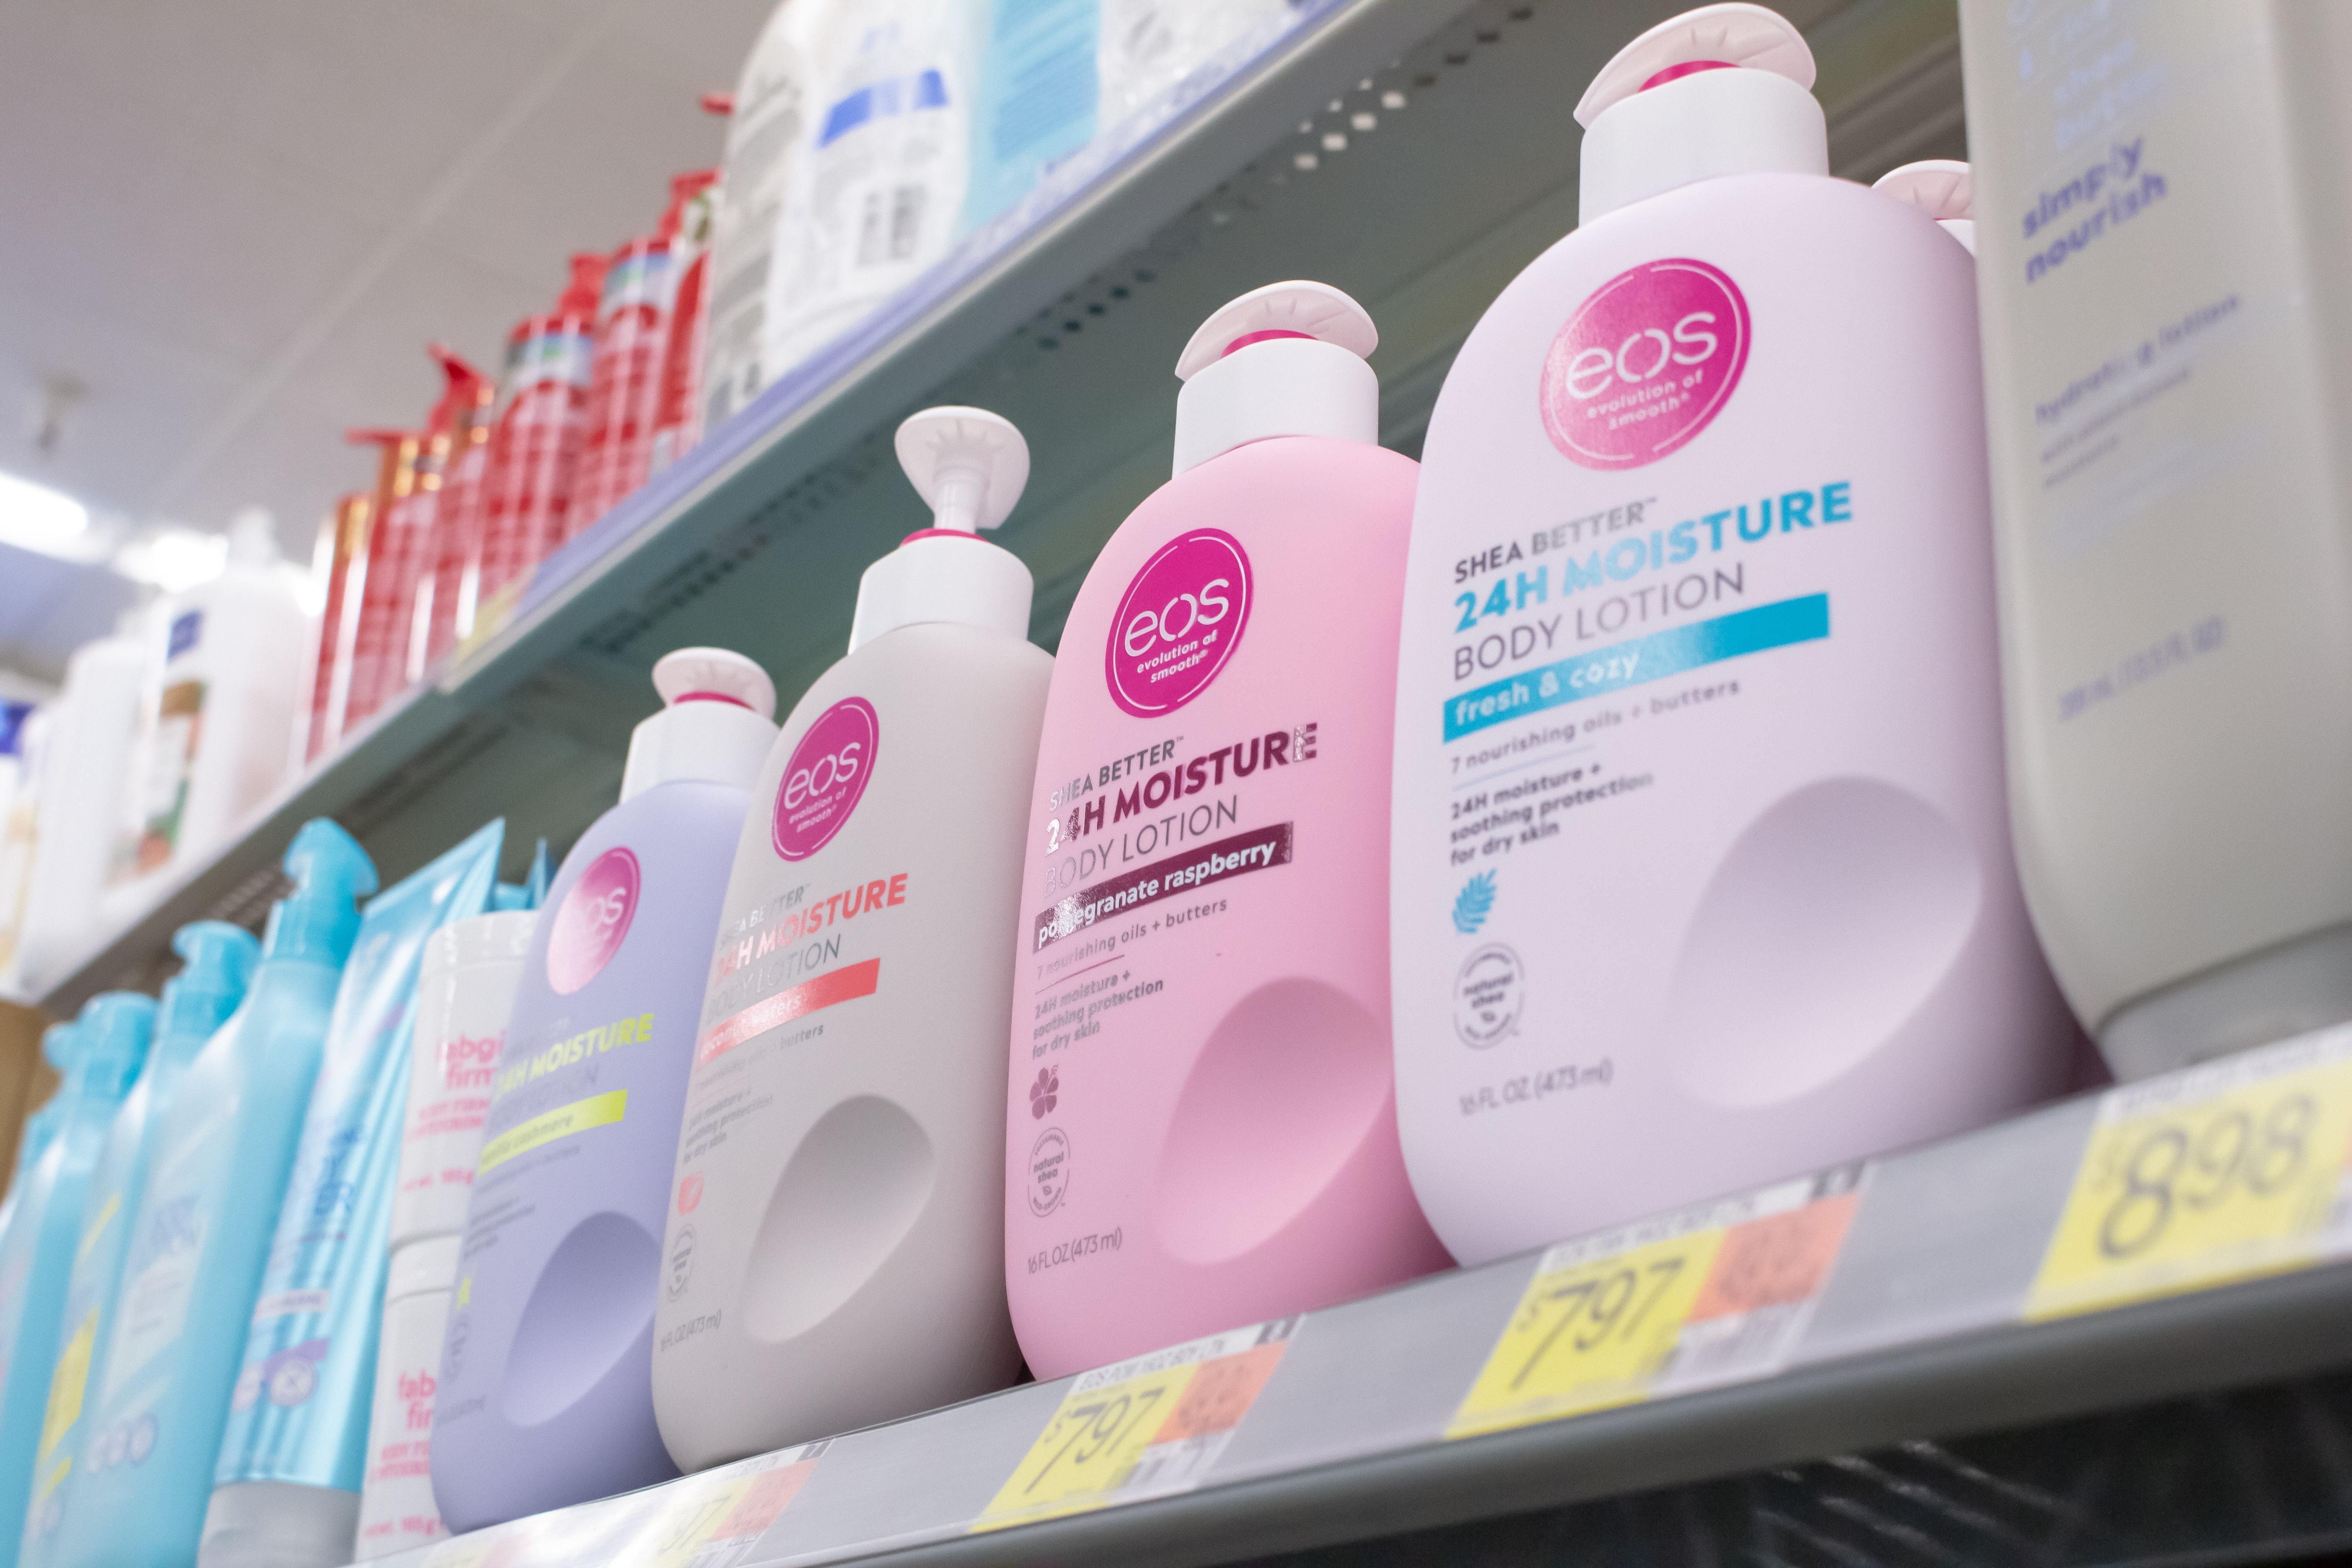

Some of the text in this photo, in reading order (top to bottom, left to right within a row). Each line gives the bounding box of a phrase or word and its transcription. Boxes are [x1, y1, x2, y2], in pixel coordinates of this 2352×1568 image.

[2026, 172, 2167, 284] nourish
[1564, 312, 1718, 399] eos
[1587, 369, 1705, 418] evolution of
[1453, 479, 1853, 634] 24H MOISTURE
[1454, 541, 1524, 584] SHEA
[1125, 578, 1230, 657] eos
[1453, 562, 1745, 681] BODY LOTION
[1137, 630, 1218, 674] evolution of
[1455, 650, 1640, 726] fresh & cozy
[1465, 723, 1576, 770] nourishing
[1583, 709, 1622, 733] oils
[1650, 680, 1740, 716] butters
[784, 741, 861, 810] eos
[789, 786, 848, 824] evolution of
[1044, 722, 1318, 857] 24H MOISTURE
[1049, 773, 1093, 813] SHEA
[1450, 793, 1488, 820] 24H
[1494, 768, 1583, 805] moisture
[1450, 772, 1655, 843] soothing protection
[1044, 794, 1238, 898] BODY LOTION
[1164, 840, 1276, 891] raspberry
[1450, 821, 1560, 867] for dry skin
[756, 872, 909, 960] MOISTURE
[1045, 934, 1116, 975] nourishing
[1121, 924, 1147, 943] oils
[1166, 899, 1228, 928] butters
[757, 933, 842, 994] LOTION
[1060, 975, 1119, 1006] moisture
[1032, 1021, 1101, 1060] for dry skin
[1033, 978, 1164, 1041] soothing protection
[530, 1012, 655, 1080] MOISTURE
[1033, 1151, 1065, 1173] natural
[1037, 1168, 1058, 1184] shea
[1027, 1254, 1037, 1275] 16
[1070, 1233, 1098, 1263] (473
[1100, 1225, 1123, 1251] ml)
